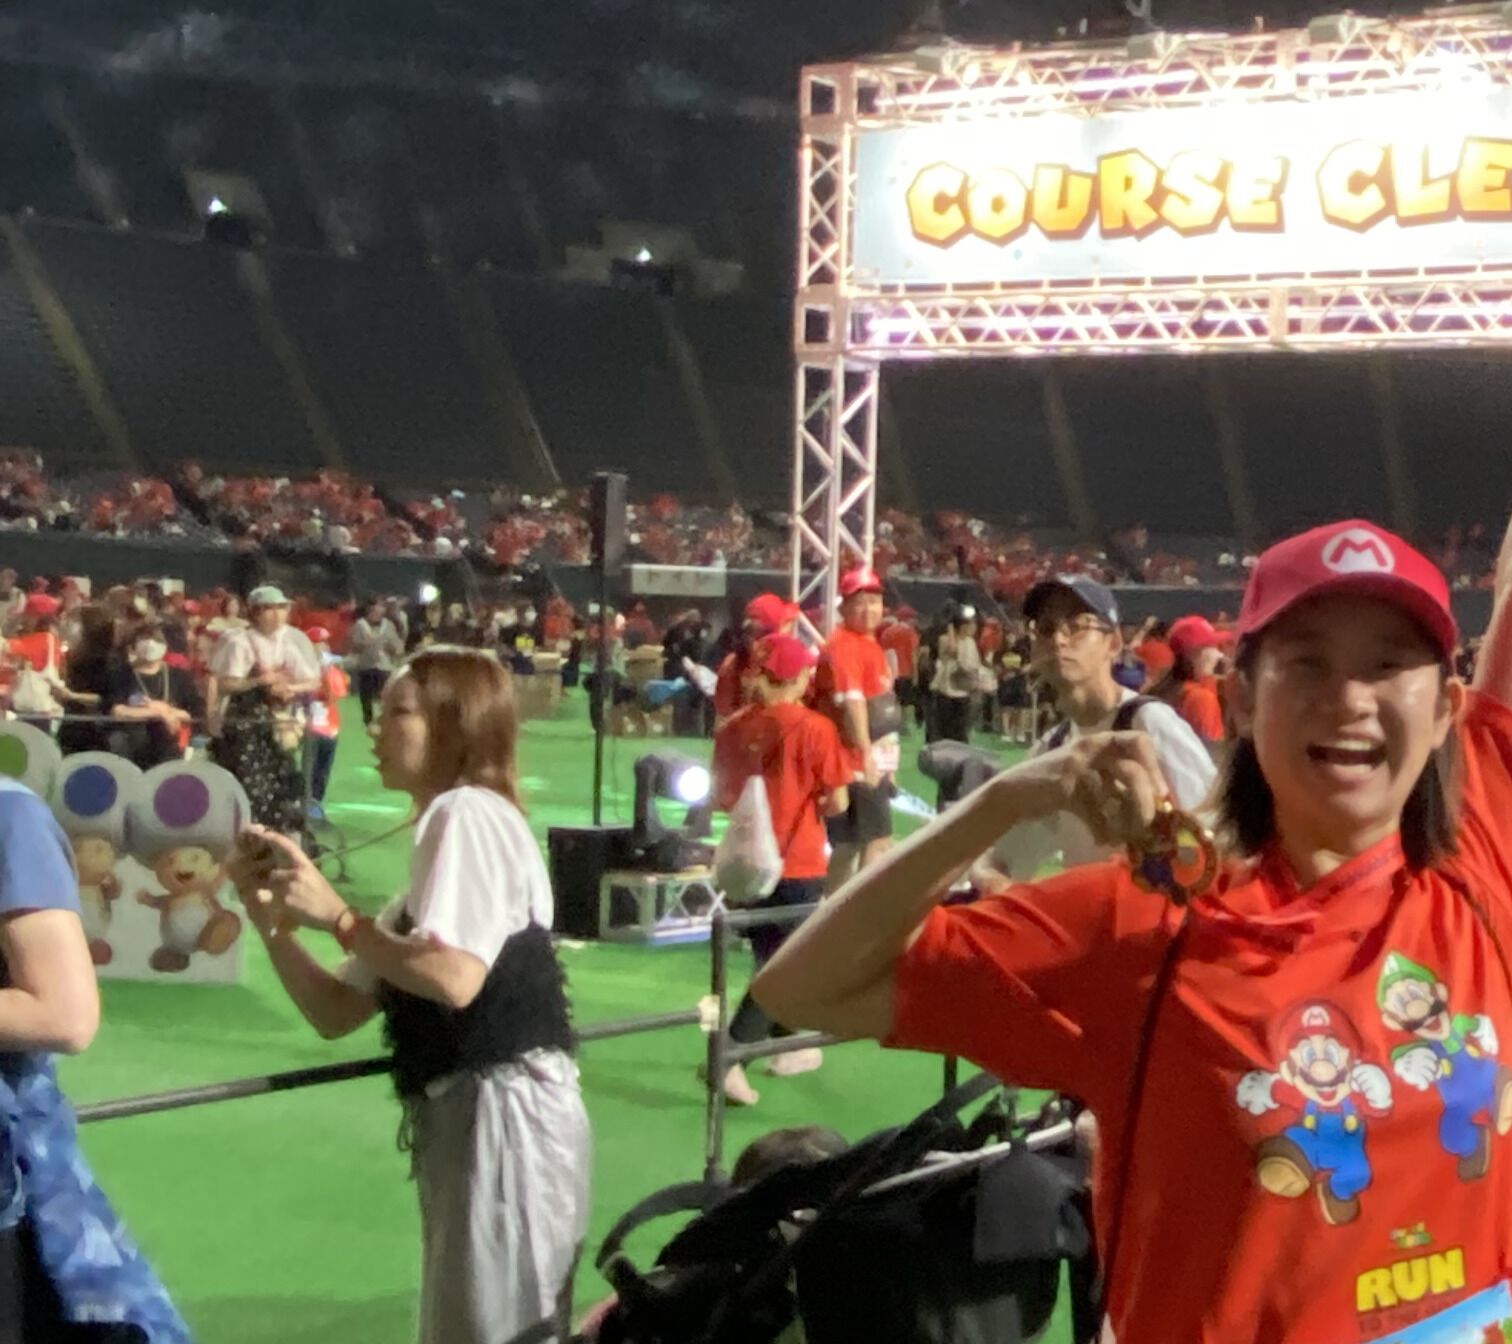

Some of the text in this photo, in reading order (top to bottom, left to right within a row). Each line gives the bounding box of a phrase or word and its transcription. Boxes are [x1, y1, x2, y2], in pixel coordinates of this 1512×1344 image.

[905, 148, 1290, 250] COURSE
[1328, 537, 1389, 567] M
[1357, 1247, 1465, 1312] RUN
